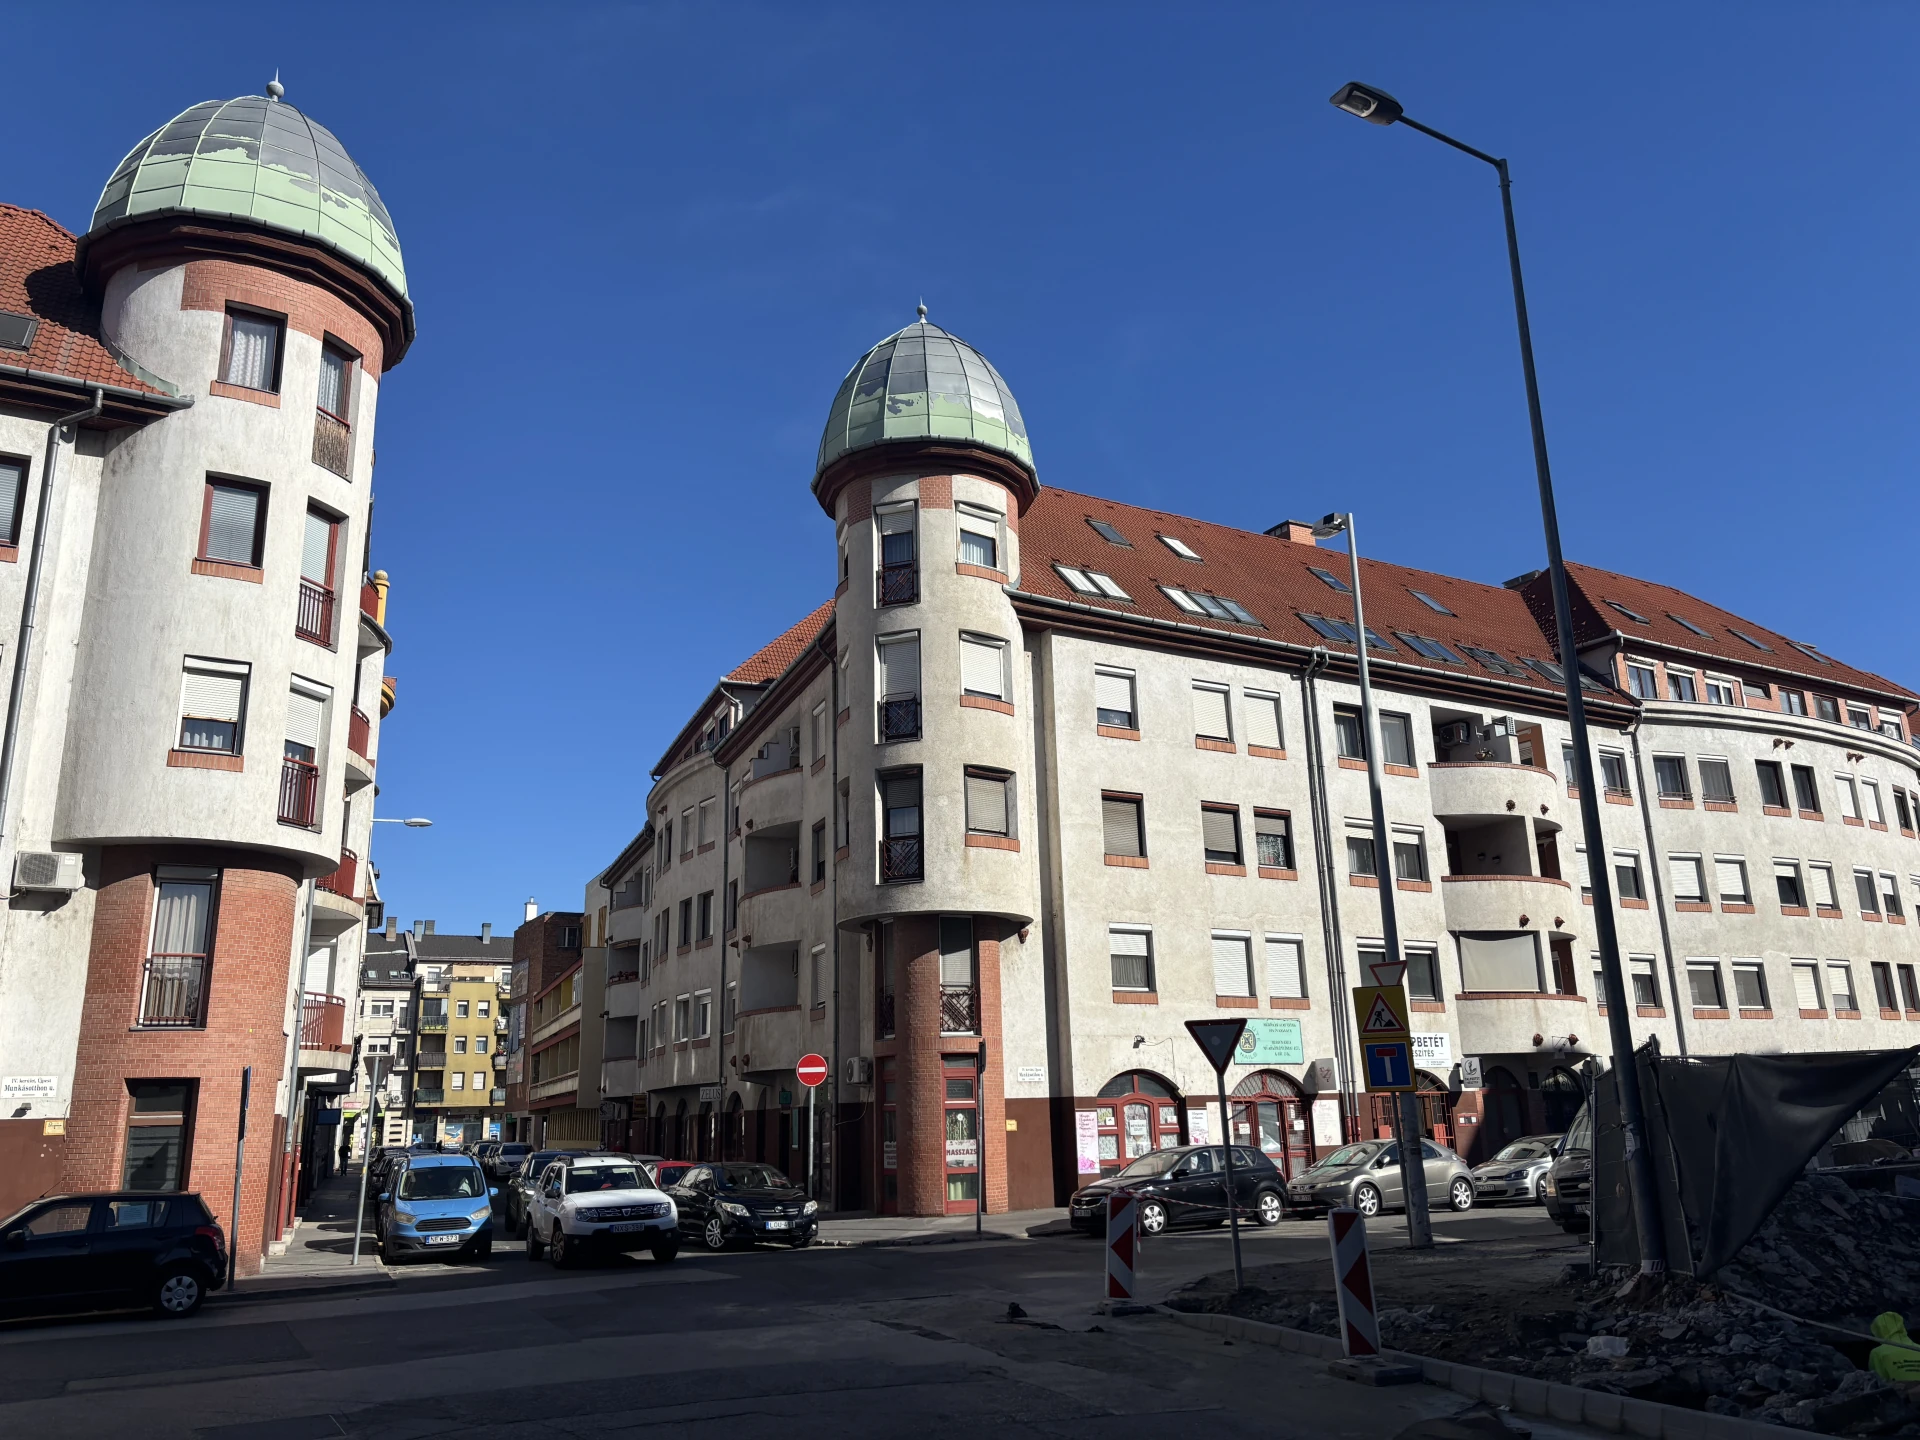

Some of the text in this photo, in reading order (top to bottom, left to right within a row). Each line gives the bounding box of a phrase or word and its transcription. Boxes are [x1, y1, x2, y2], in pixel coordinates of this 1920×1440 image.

[1412, 1048, 1434, 1057] SZÍTÉS
[701, 1088, 721, 1100] ZELUS
[946, 1148, 977, 1156] MASSZÁZS
